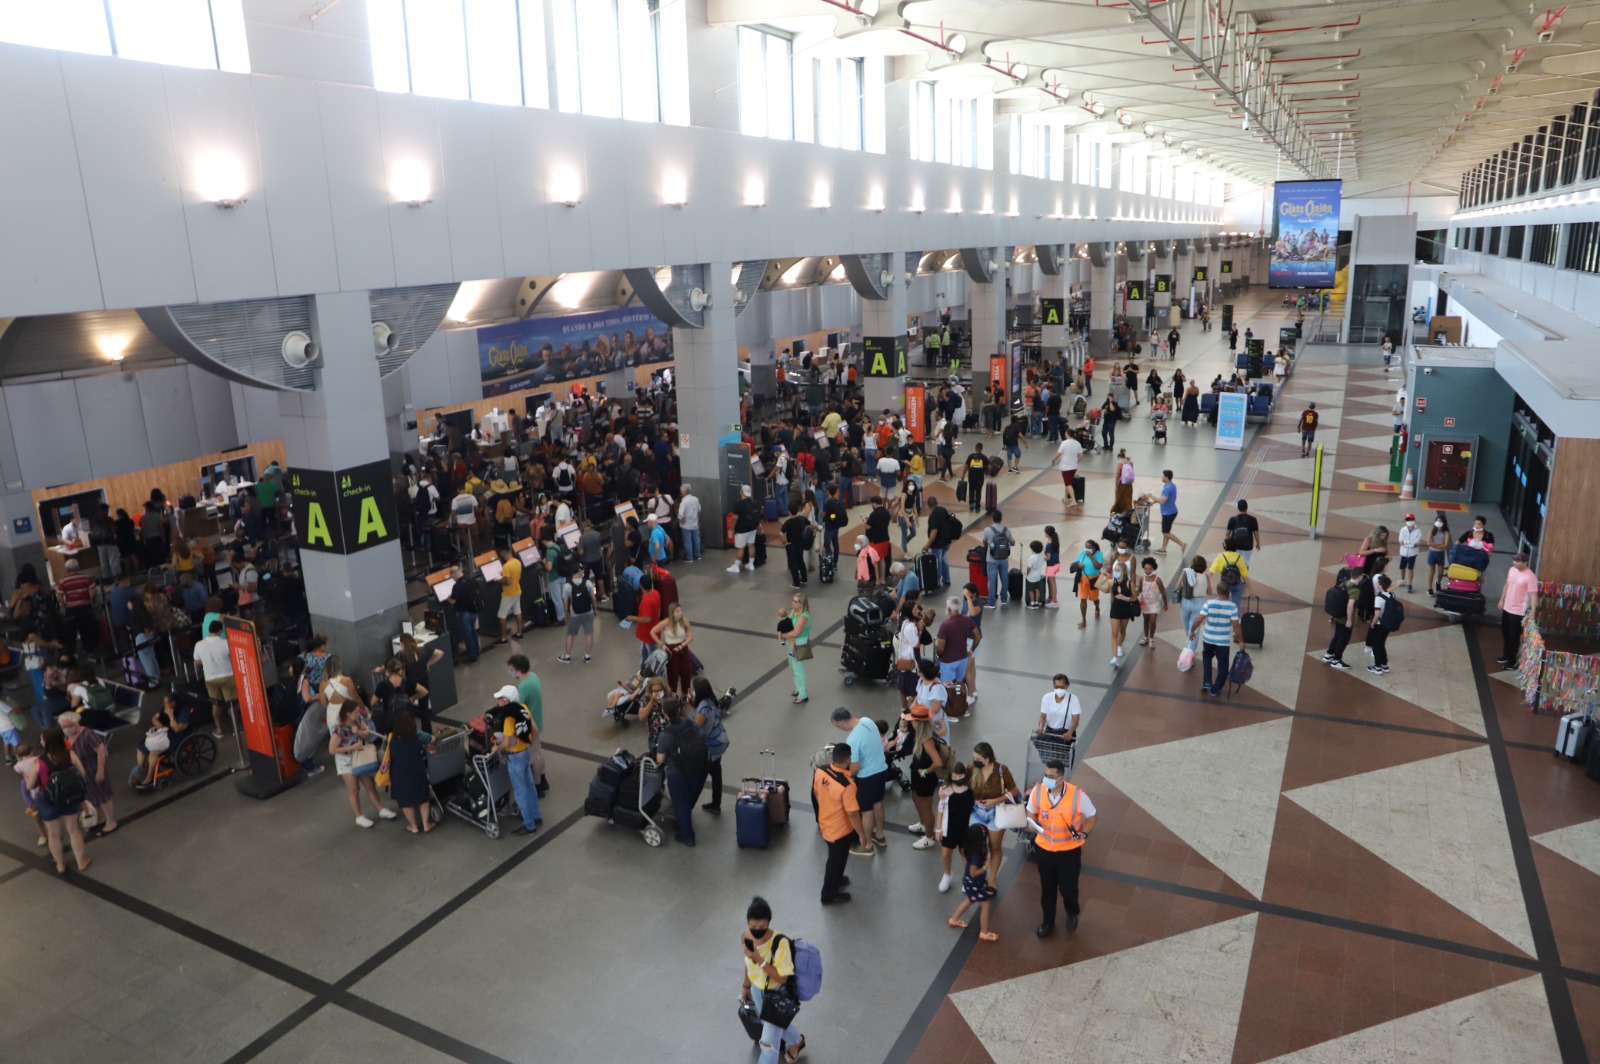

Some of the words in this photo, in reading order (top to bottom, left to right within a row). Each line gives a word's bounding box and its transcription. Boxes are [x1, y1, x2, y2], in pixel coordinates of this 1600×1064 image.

[1280, 201, 1304, 217] Glass
[1305, 200, 1333, 217] Onion
[1158, 282, 1165, 290] B
[1130, 288, 1140, 299] A
[1047, 309, 1059, 323] A
[871, 353, 888, 374] A
[898, 352, 906, 374] A
[1306, 414, 1314, 424] 10
[294, 488, 317, 496] check-in
[343, 485, 371, 496] check-in
[308, 502, 333, 546] A
[358, 496, 388, 544] A
